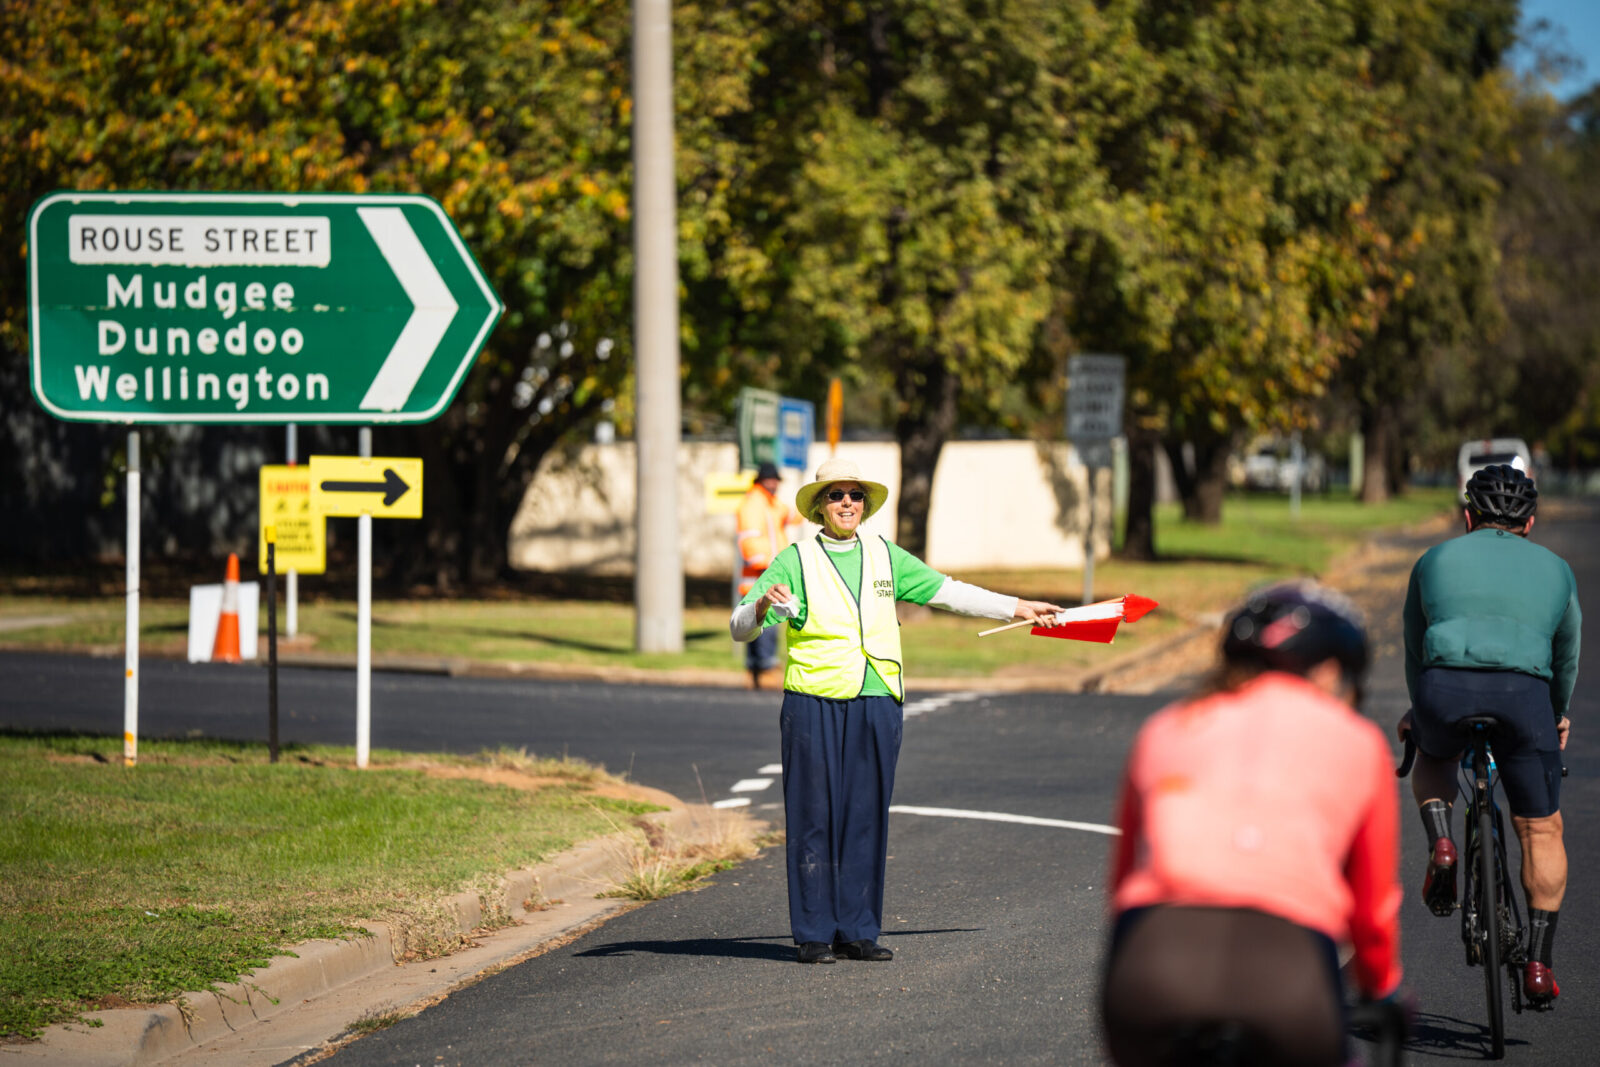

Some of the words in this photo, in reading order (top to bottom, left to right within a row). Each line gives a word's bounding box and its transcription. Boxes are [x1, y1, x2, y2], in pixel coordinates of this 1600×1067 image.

[80, 227, 184, 252] ROUSE
[204, 228, 318, 253] STREET
[106, 274, 295, 319] Mudgee
[98, 320, 304, 355] Dunedoo
[74, 365, 330, 411] Wellington
[873, 580, 892, 588] EVEN
[876, 589, 893, 598] STAF
